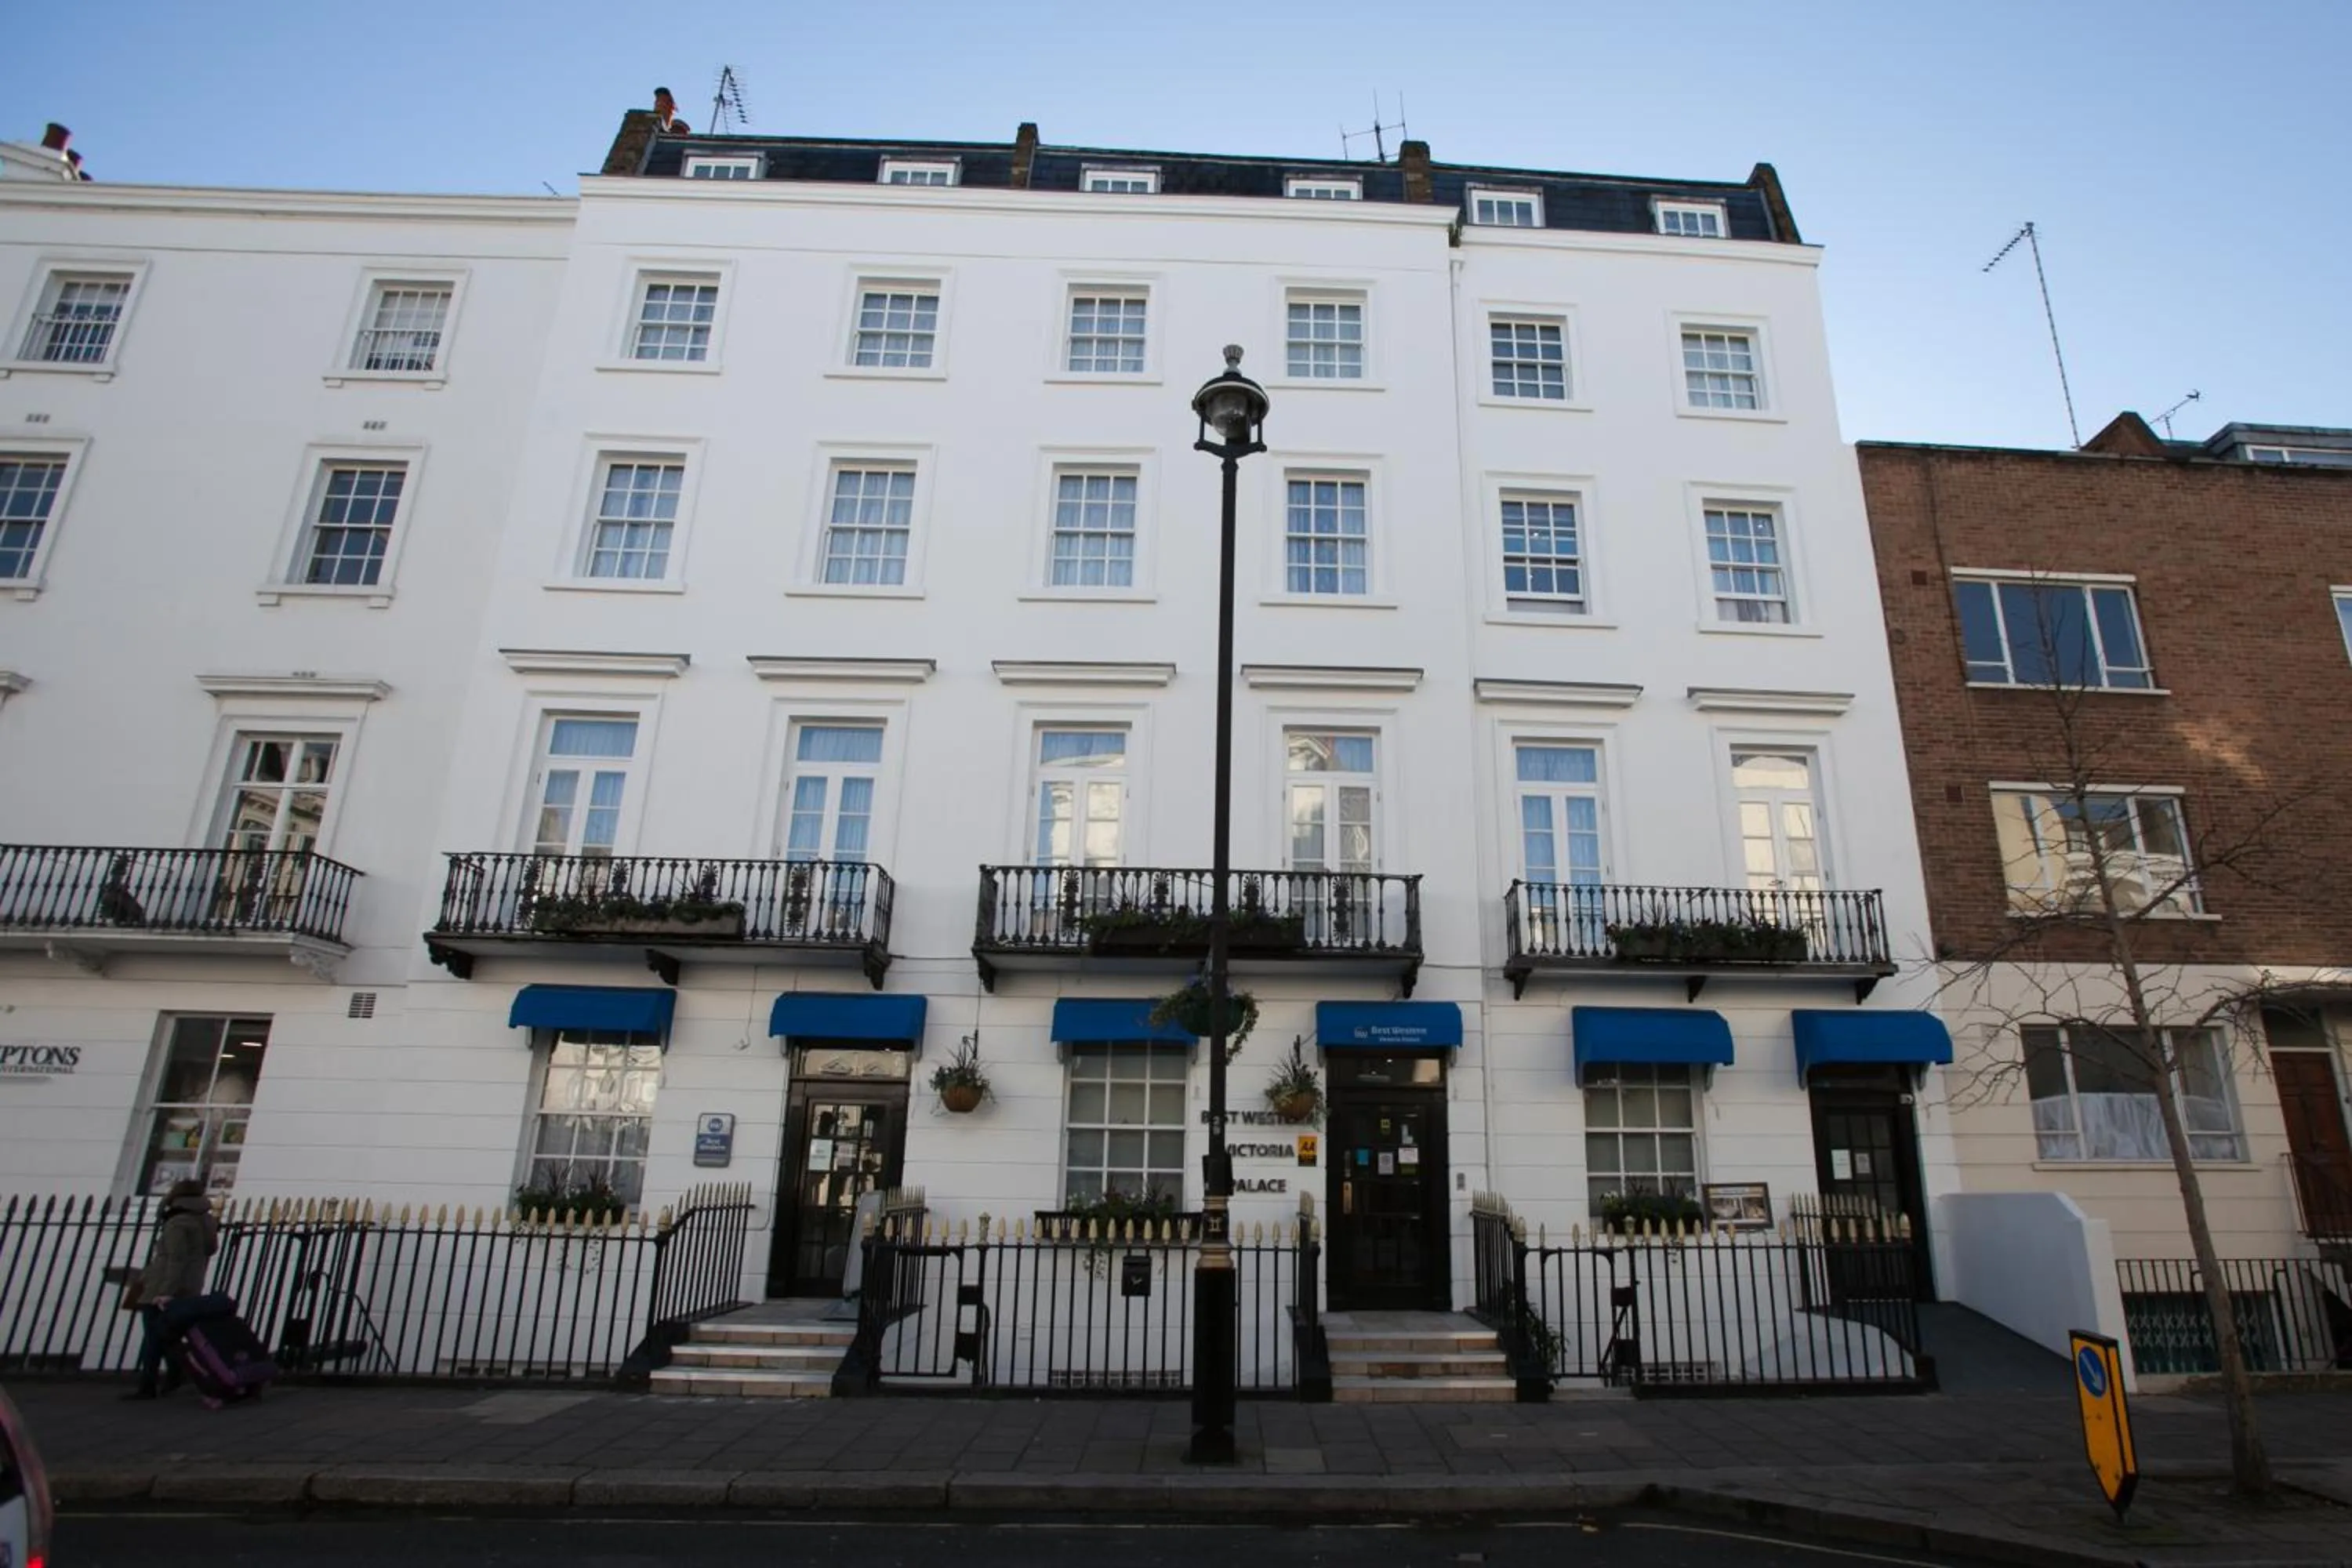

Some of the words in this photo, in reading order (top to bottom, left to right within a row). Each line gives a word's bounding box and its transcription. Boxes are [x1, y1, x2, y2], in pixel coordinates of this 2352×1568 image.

[0, 1045, 82, 1065] PTONS
[1201, 1110, 1239, 1125] BST
[1241, 1110, 1315, 1125] WEST
